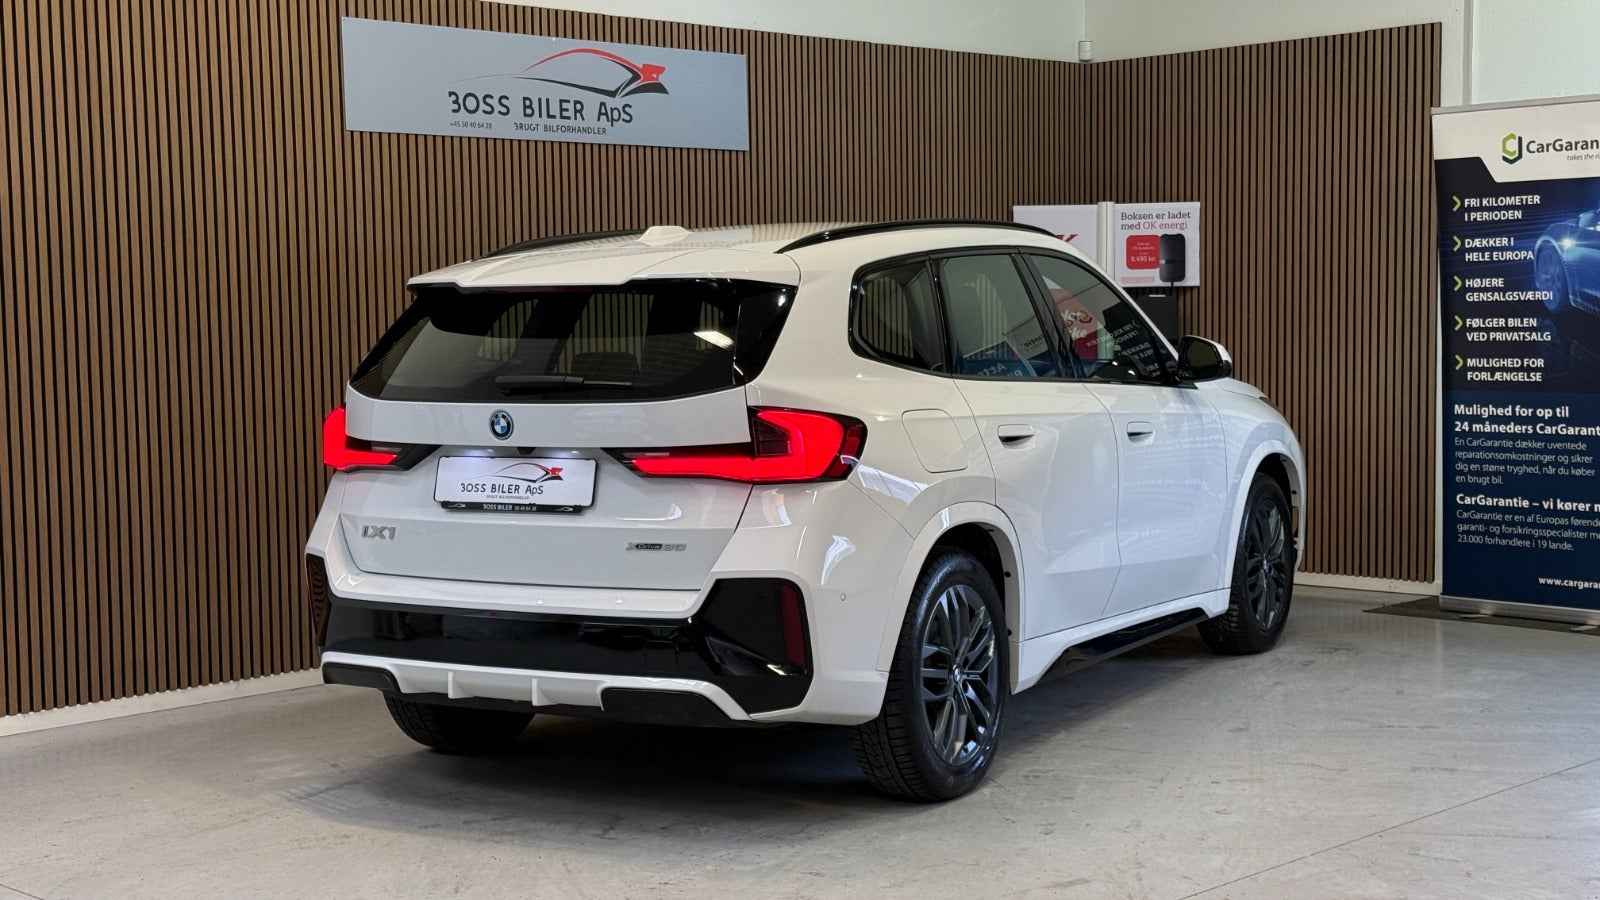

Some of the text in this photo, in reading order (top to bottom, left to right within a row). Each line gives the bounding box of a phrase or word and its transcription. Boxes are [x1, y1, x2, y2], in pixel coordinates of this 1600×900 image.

[522, 96, 585, 122] BILER
[597, 102, 633, 127] ApS
[544, 124, 606, 135] BILFORHANDLER
[1526, 138, 1600, 154] CarGaran
[1464, 194, 1540, 208] FRI KILOMETER
[1121, 212, 1154, 220] Boksen
[1168, 211, 1192, 220] ladet
[1464, 210, 1522, 222] I PERIODEN
[1121, 222, 1188, 230] med OK energi
[1465, 238, 1514, 248] DÆKKER I
[1466, 251, 1534, 262] HELE EUROPA
[1466, 278, 1504, 288] HØJERE
[1466, 291, 1553, 302] GENSALGSVÆRDI
[1466, 318, 1537, 328] FØLGER BILEN
[1466, 331, 1551, 342] VED PRIVATSALG
[1467, 358, 1544, 368] MULIGHED FOR
[1467, 372, 1542, 382] FORLÆNGELSE
[1454, 404, 1570, 420] Mulighed for op til
[1454, 421, 1600, 436] 24 måneders CarGarant
[1454, 438, 1588, 450] En CarGarantie dækker uventede
[1455, 451, 1593, 464] reparationsomkostninger og sikrer
[1455, 462, 1468, 472] dig
[1482, 463, 1506, 472] større
[1506, 464, 1541, 476] tryghed,
[1542, 465, 1556, 474] når
[1558, 466, 1570, 476] du
[1571, 466, 1596, 476] køber
[1468, 474, 1490, 486] brugt
[1492, 476, 1504, 484] bil.
[491, 484, 520, 494] BILER
[525, 484, 544, 496] ApS
[1456, 494, 1530, 508] CarGarantie
[1542, 498, 1554, 510] vi
[1557, 498, 1591, 512] kører
[1456, 510, 1502, 520] CarGarantie
[1504, 514, 1512, 522] er
[1514, 514, 1525, 522] en
[1526, 514, 1535, 523] af
[1536, 514, 1568, 526] Europas
[1457, 524, 1488, 532] garanti-
[1489, 526, 1500, 535] og
[1502, 524, 1588, 539] forsikringsspecialister
[1458, 534, 1484, 544] 23.000
[1484, 536, 1531, 548] forhandlere
[1538, 540, 1546, 549] 19
[1548, 541, 1574, 551] lande.
